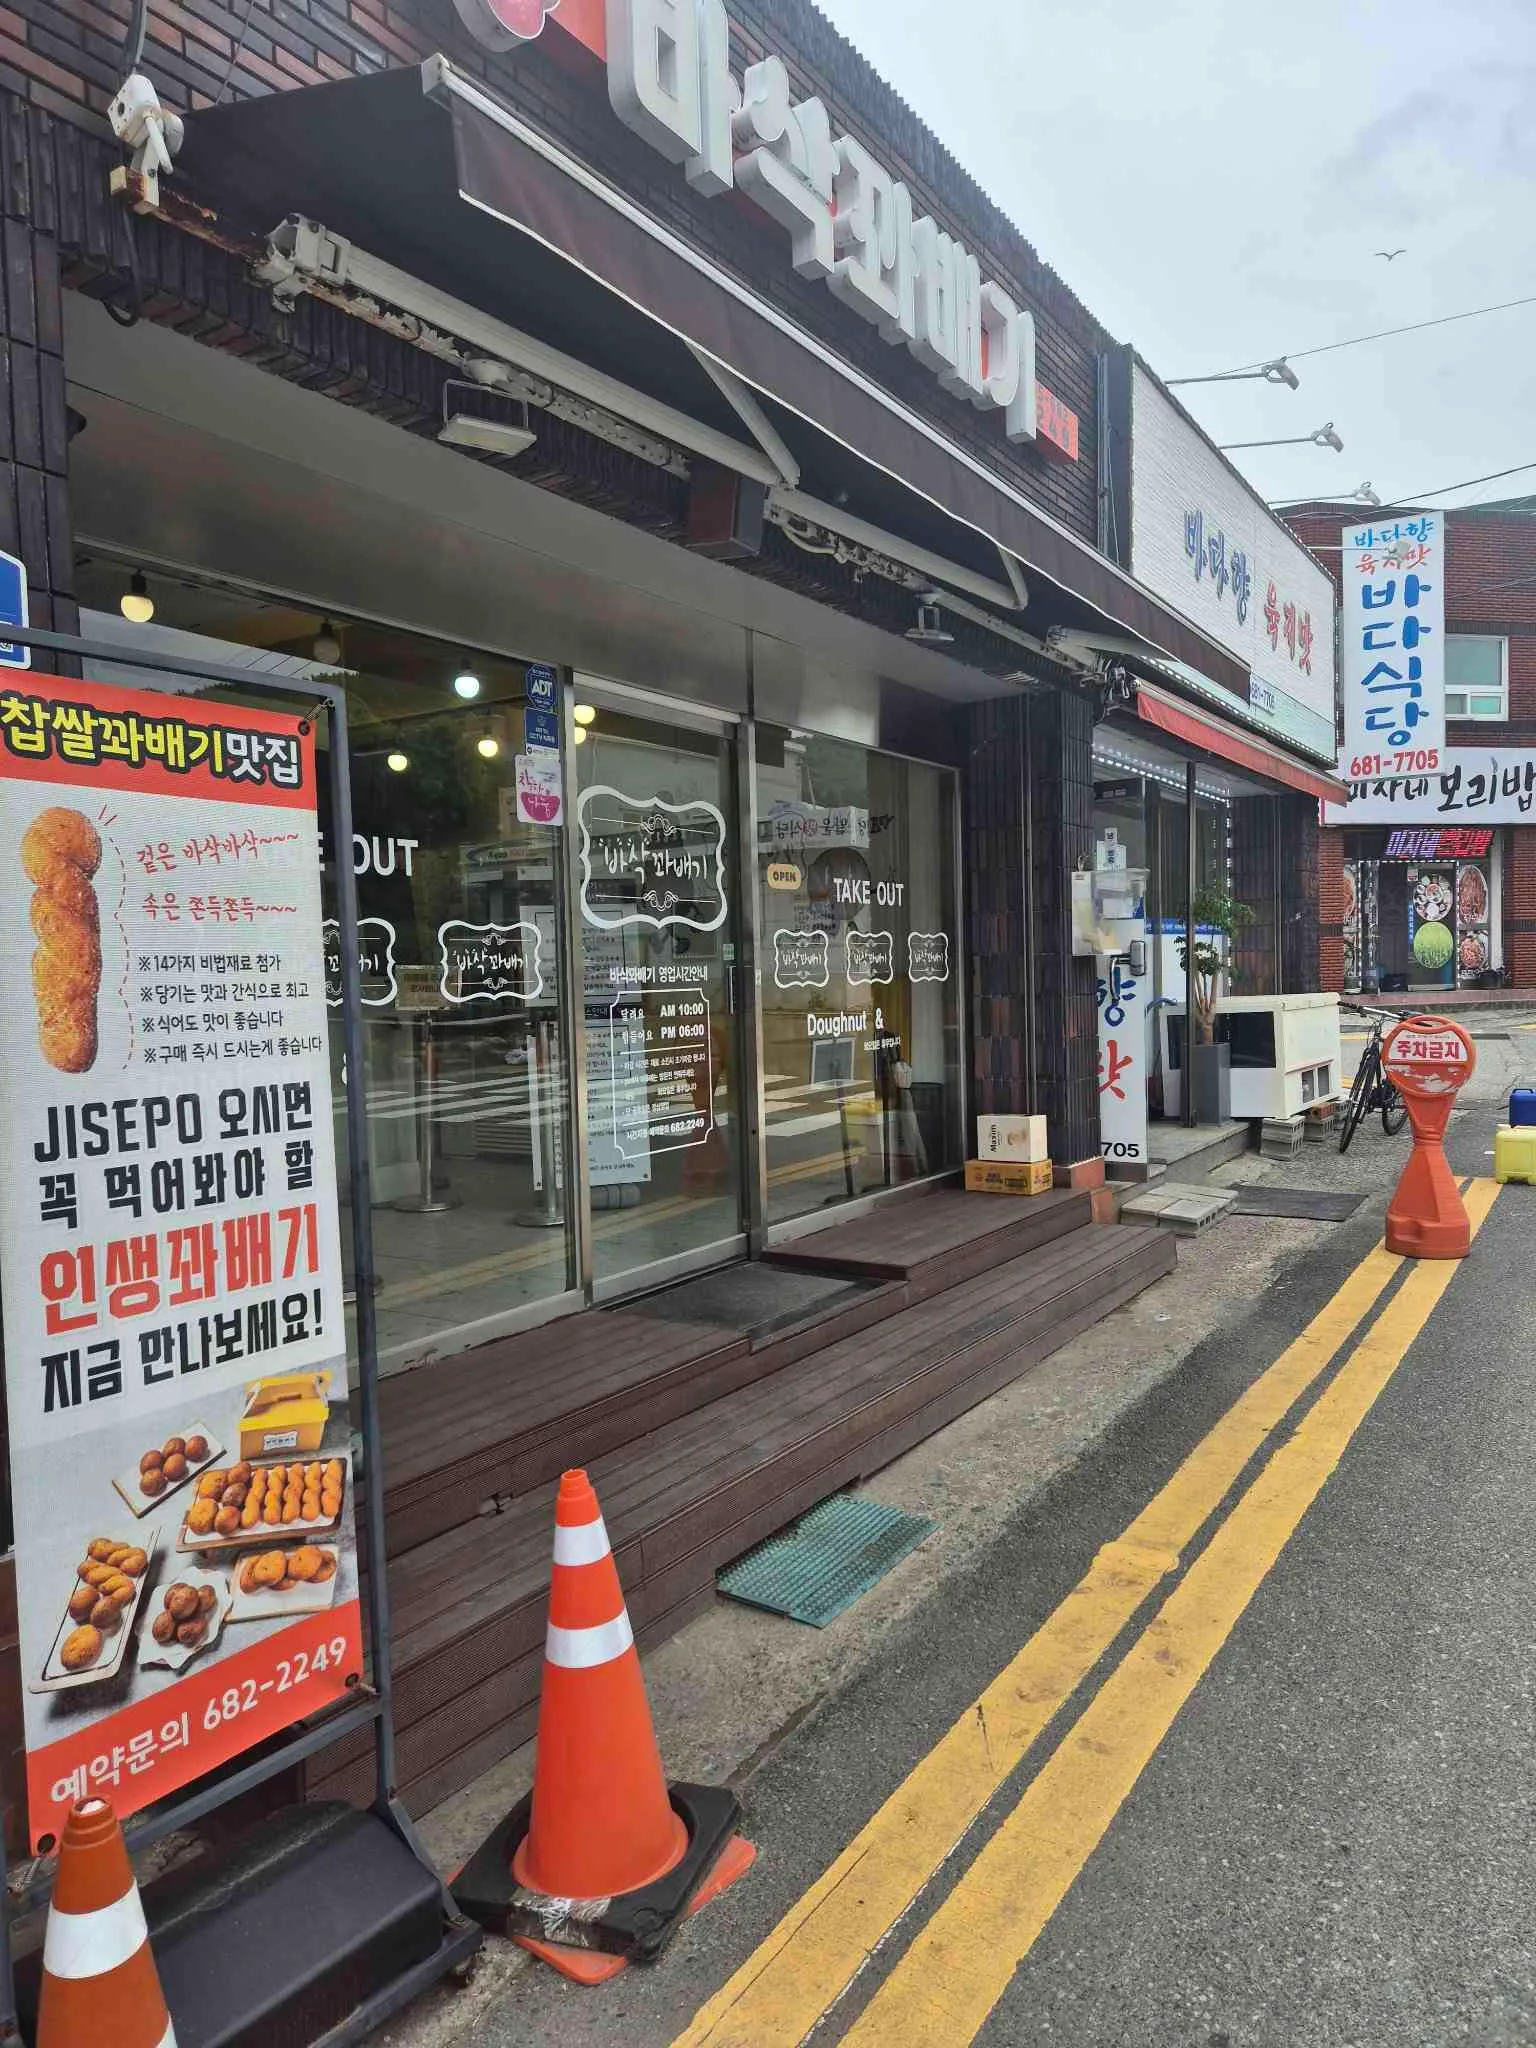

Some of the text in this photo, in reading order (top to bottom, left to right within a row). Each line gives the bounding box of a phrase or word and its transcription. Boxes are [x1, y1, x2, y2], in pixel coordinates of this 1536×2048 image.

[1354, 517, 1434, 548] 바다향
[1184, 510, 1251, 626] 바다향
[1361, 574, 1432, 746] 바다식당
[531, 679, 553, 697] ADT
[1350, 749, 1438, 777] 681-7705
[1437, 757, 1536, 813] 보리밥
[136, 848, 177, 873] 겉은
[352, 833, 419, 878] OUT
[773, 870, 798, 883] OPEN
[833, 878, 905, 907] TAKE OUT
[142, 892, 181, 922] 속은
[199, 953, 254, 974] 비법재료
[256, 955, 282, 973] 첨가
[659, 966, 708, 983] 영업시간안내
[200, 982, 227, 1002] 맛과
[231, 981, 282, 1002] 간식으로
[285, 980, 310, 1000] 최고
[202, 1013, 229, 1032] 맛이
[233, 1010, 283, 1030] 좋습니다
[660, 1003, 704, 1017] AM 10:00
[807, 1010, 867, 1038] Doughnut
[661, 1024, 704, 1039] PM 06:00
[192, 1043, 219, 1063] 즉시
[223, 1039, 276, 1060] 드시는게
[278, 1035, 323, 1058] 좋습니다
[1397, 1040, 1460, 1060] 주차금지
[33, 1081, 313, 1163] JISEPO 오시면
[40, 1140, 313, 1230] 꼭 먹어봐야 할
[40, 1203, 320, 1336] 인생꽈배기
[40, 1288, 323, 1414] 지금 만나보세요!
[50, 1636, 348, 1804] 예약문의 682-2249
